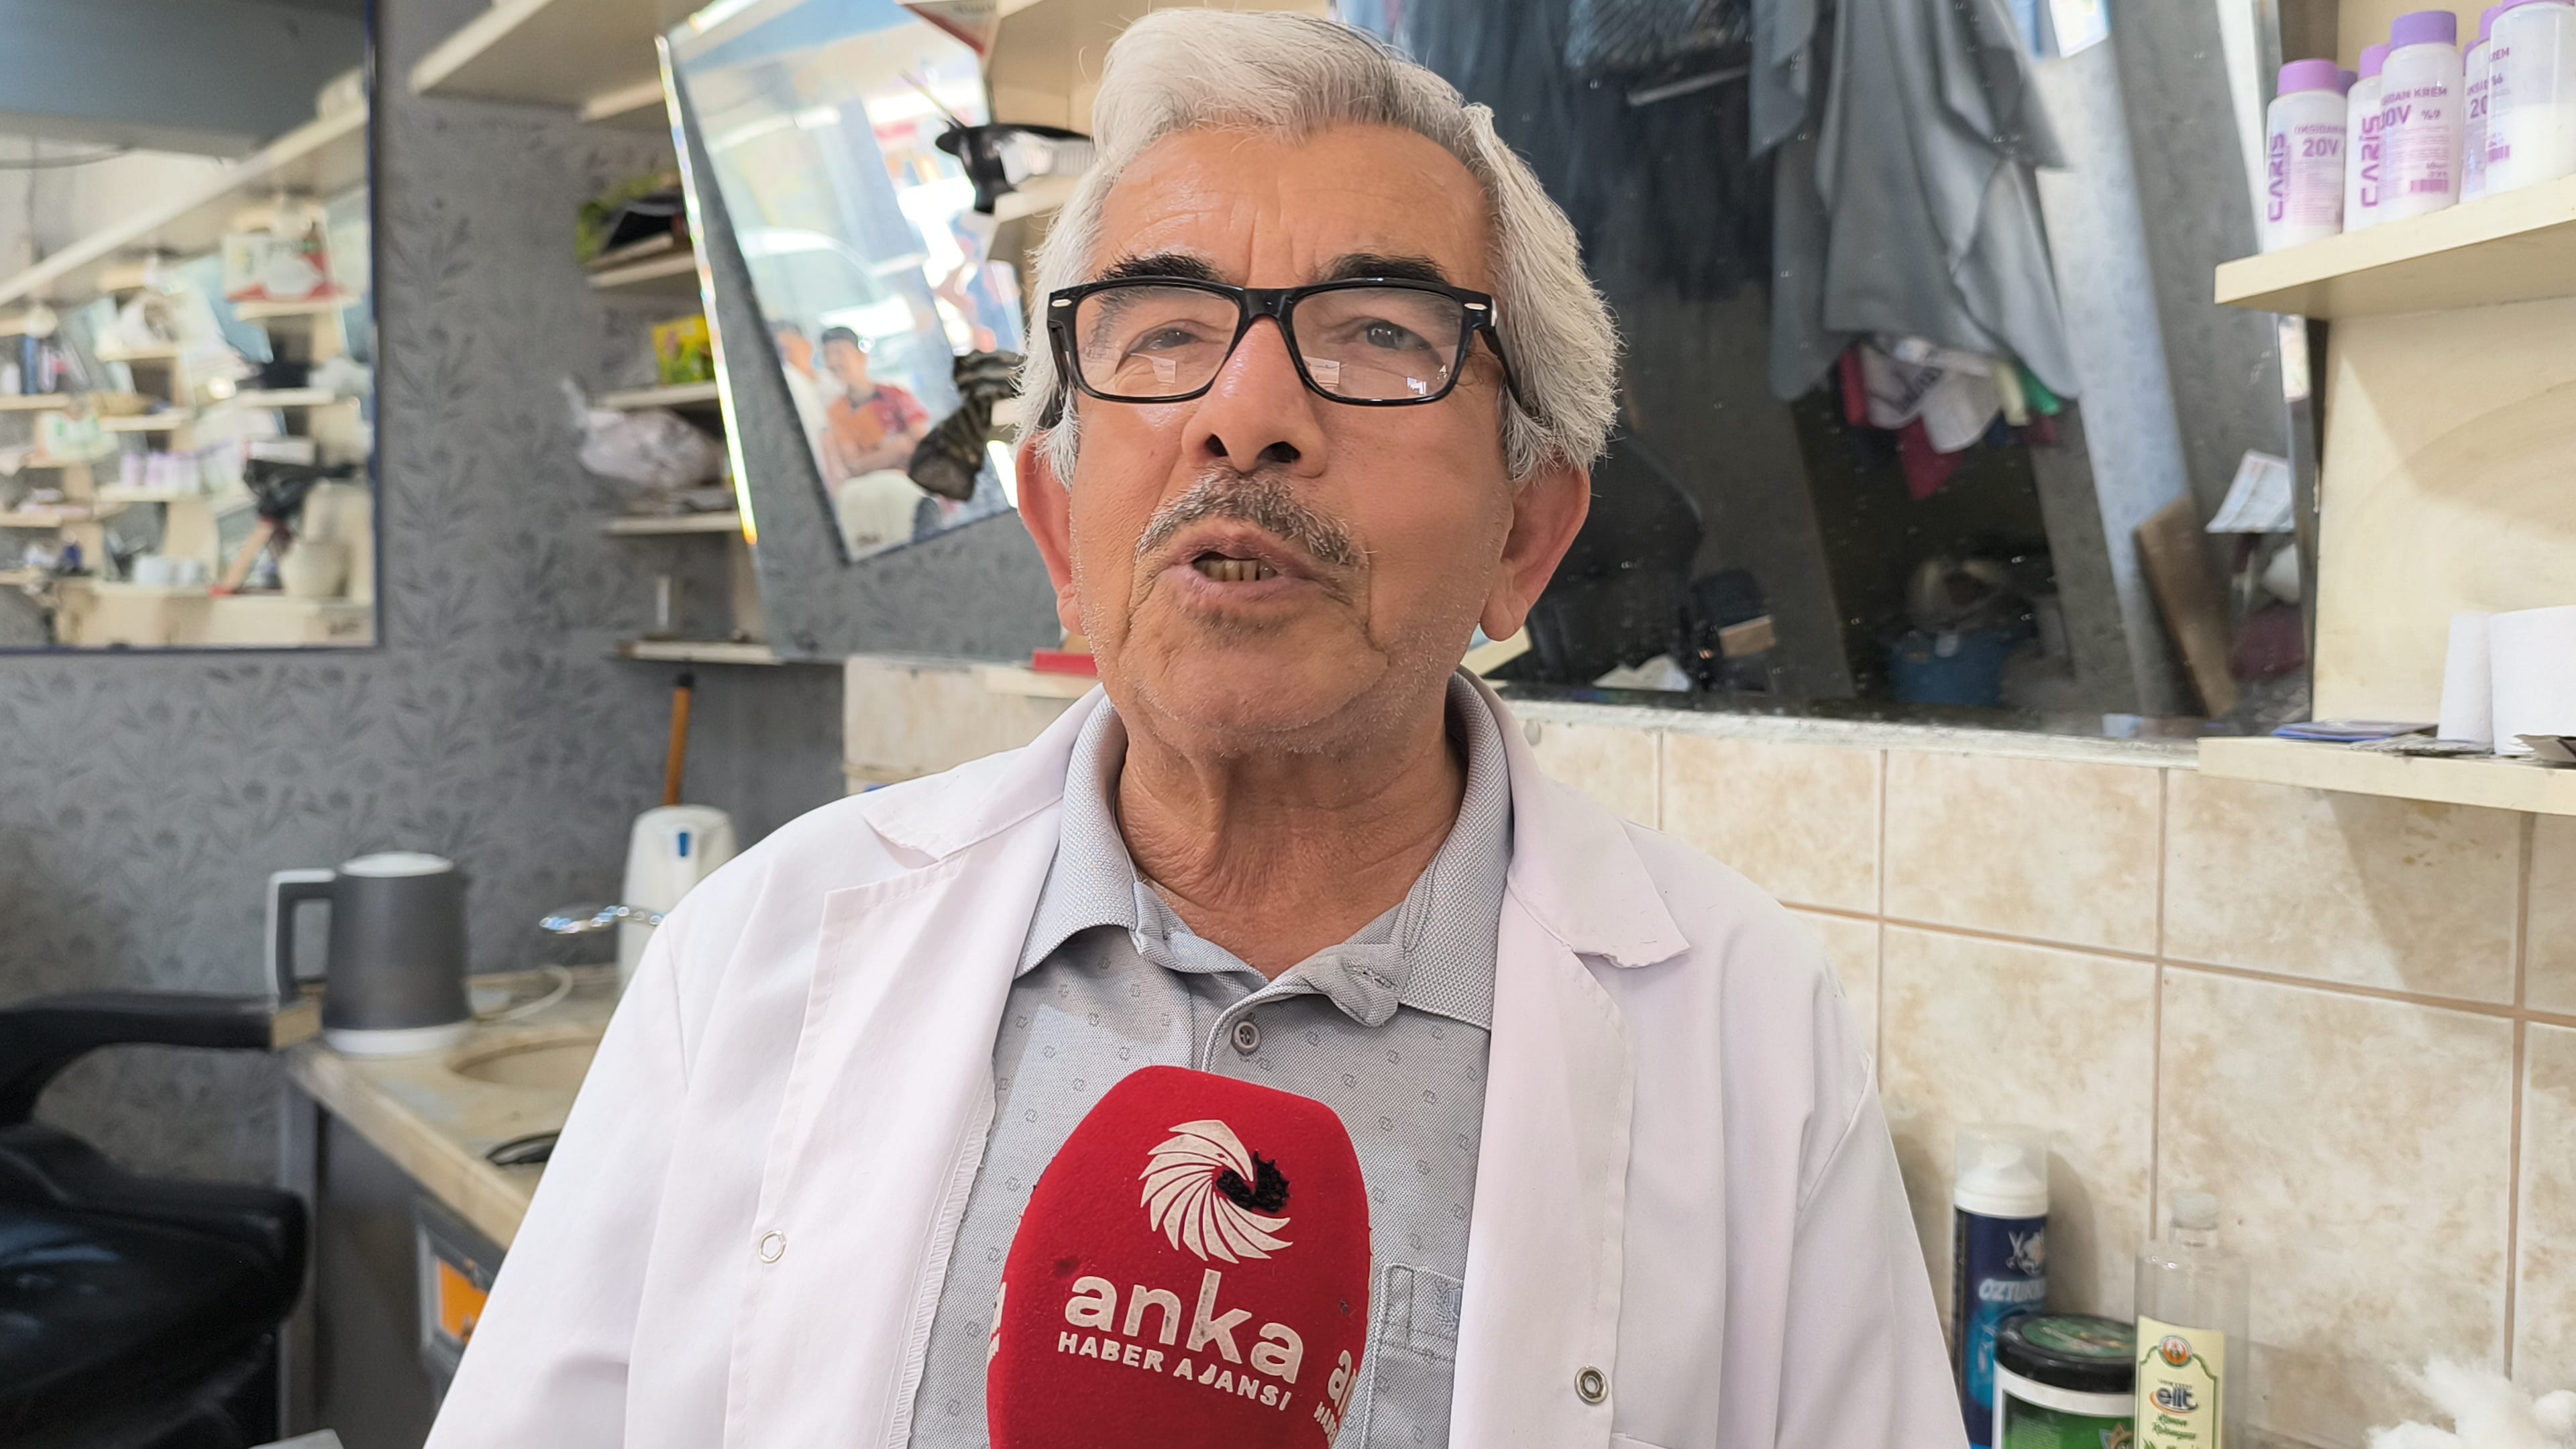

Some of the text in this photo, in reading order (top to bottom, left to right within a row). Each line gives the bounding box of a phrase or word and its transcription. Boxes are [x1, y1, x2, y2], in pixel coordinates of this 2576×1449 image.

[2414, 88, 2447, 97] KREM
[2302, 137, 2339, 157] 20V
[1065, 1268, 1303, 1384] anka
[1057, 1331, 1292, 1411] HABER AJANSI
